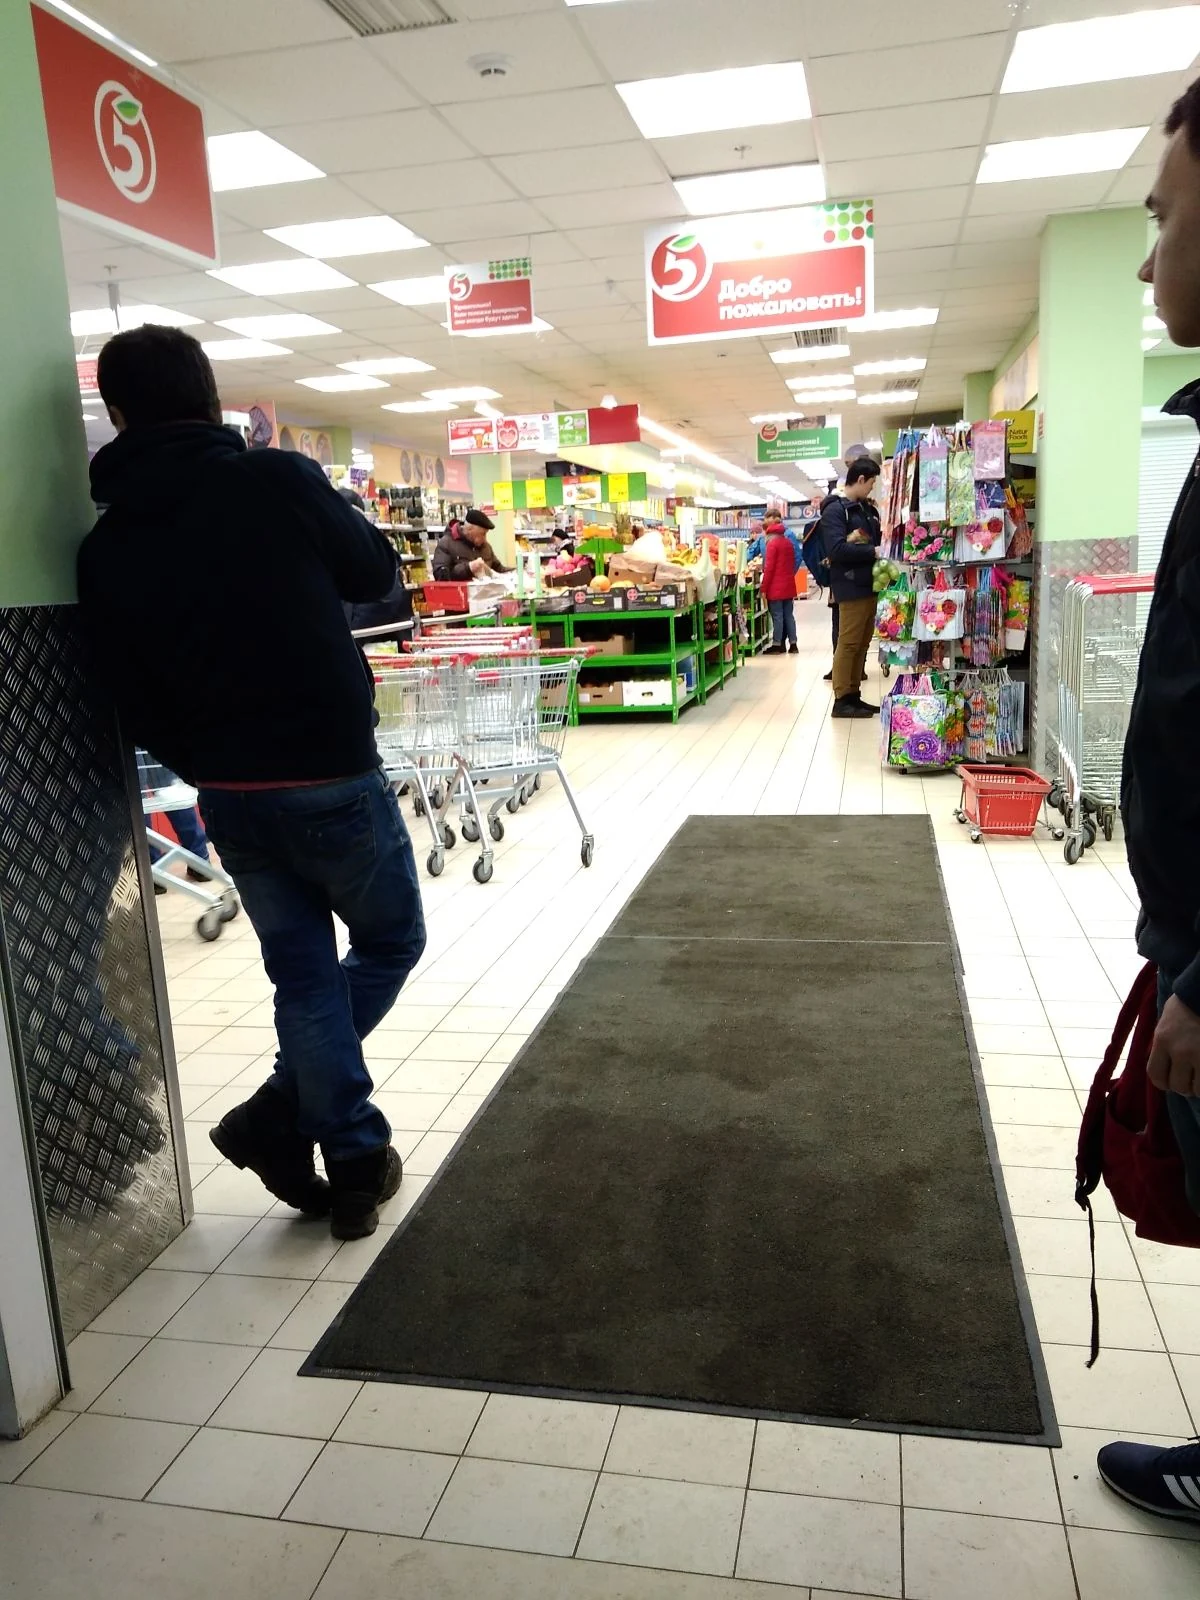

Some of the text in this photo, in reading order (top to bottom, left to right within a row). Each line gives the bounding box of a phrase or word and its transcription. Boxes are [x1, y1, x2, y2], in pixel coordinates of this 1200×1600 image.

[717, 275, 792, 304] Добро
[719, 286, 863, 320] пожаловать!
[776, 437, 820, 447] Внимание!
